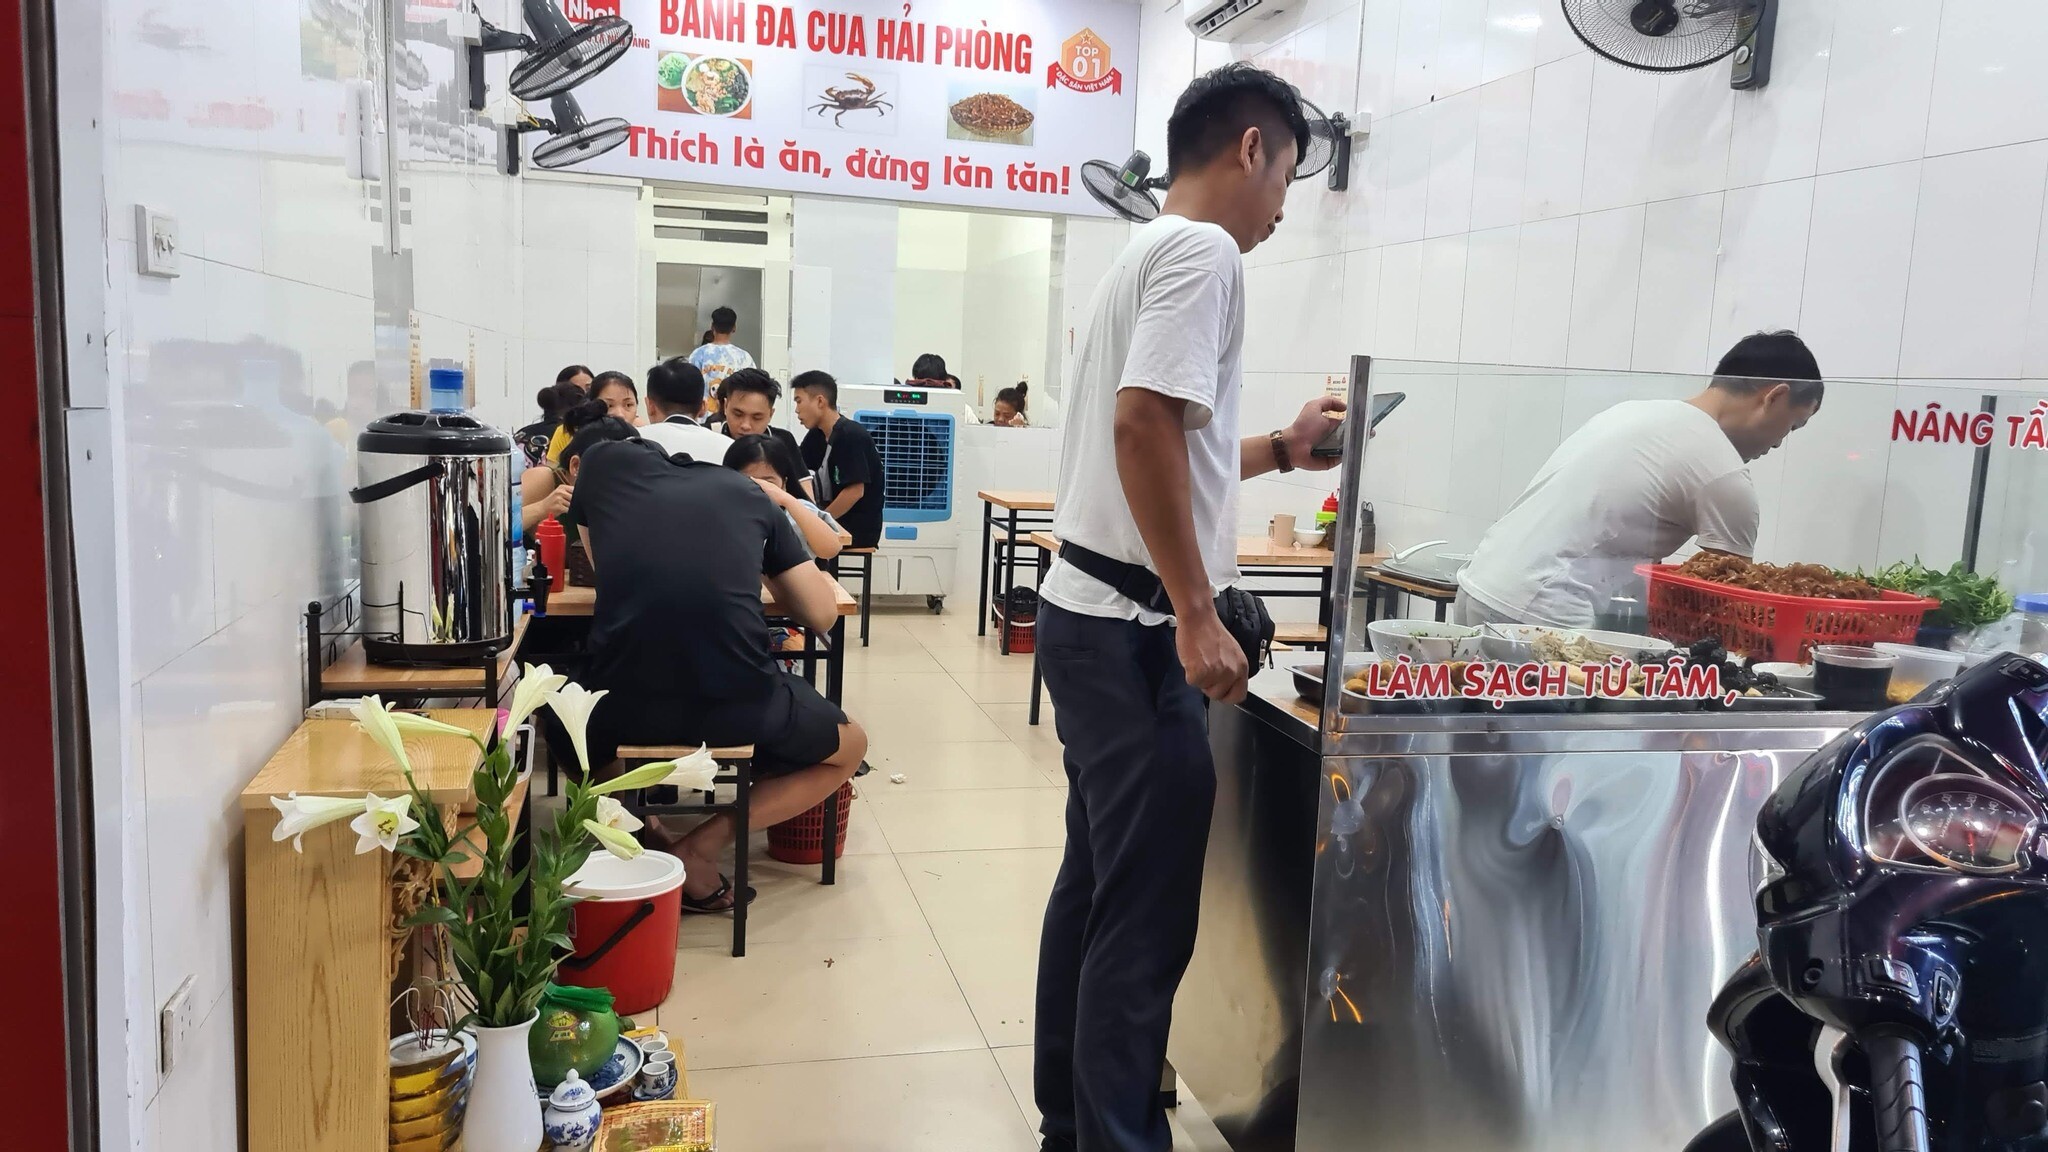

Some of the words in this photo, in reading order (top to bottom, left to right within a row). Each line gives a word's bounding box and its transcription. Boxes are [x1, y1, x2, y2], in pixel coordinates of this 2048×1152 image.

[756, 4, 797, 49] ĐA
[807, 10, 867, 57] CUA
[876, 3, 926, 64] HẢI
[935, 20, 1033, 75] PHÒNG
[1075, 45, 1099, 57] TOP
[1072, 56, 1101, 79] 01
[1099, 74, 1114, 88] NAM
[627, 125, 719, 165] Thích
[733, 135, 765, 169] là
[778, 138, 832, 178] ăn,
[845, 147, 930, 191] đừng
[943, 155, 993, 189] lăn
[1006, 160, 1071, 196] tăn!
[1891, 402, 1994, 446] NÂNG
[2006, 400, 2048, 448] TẦ
[1369, 656, 1450, 698] LÀM
[1463, 663, 1567, 708] SẠCH
[1581, 656, 1632, 697] TỪ
